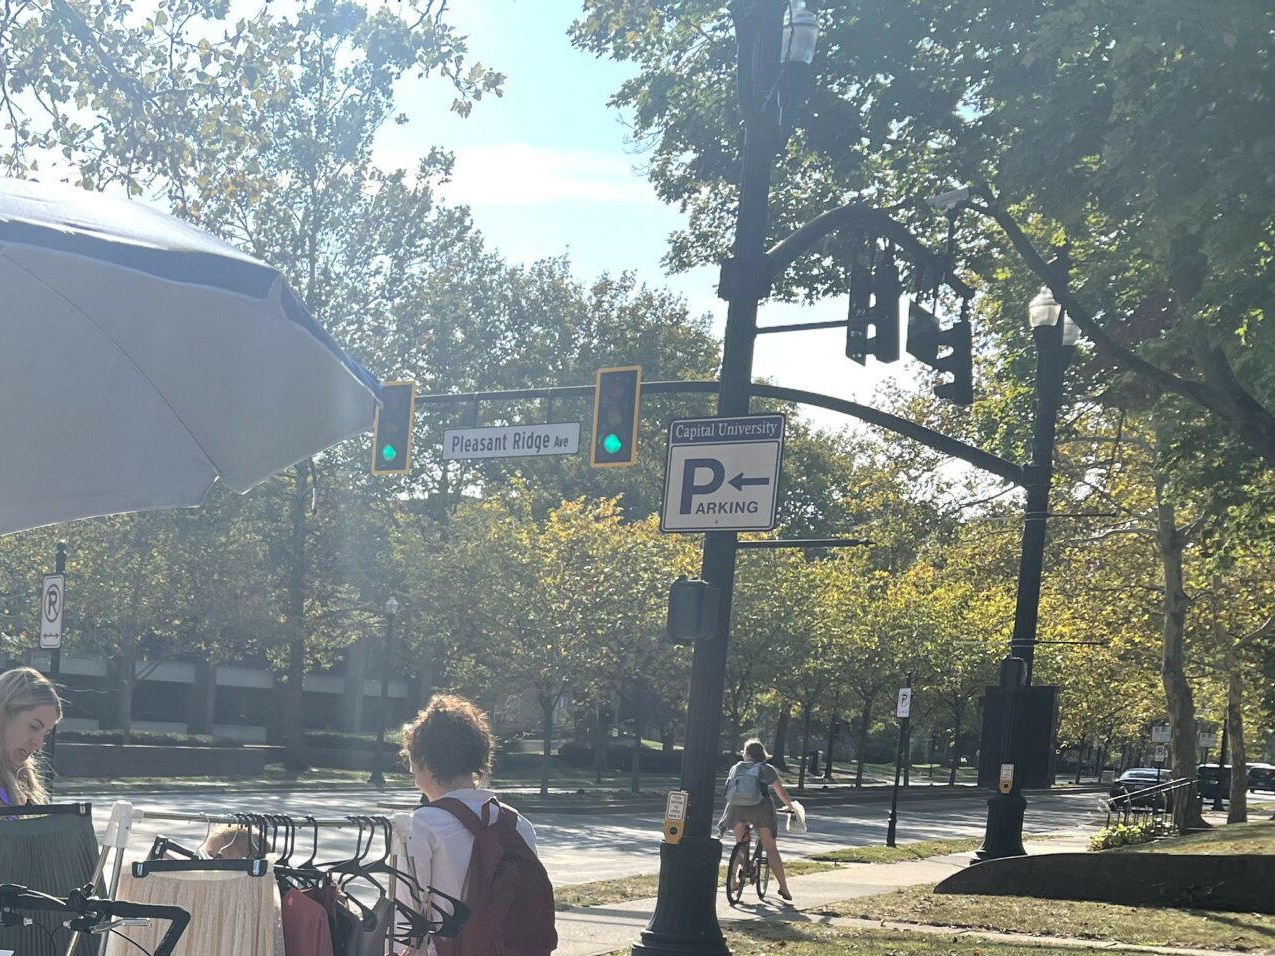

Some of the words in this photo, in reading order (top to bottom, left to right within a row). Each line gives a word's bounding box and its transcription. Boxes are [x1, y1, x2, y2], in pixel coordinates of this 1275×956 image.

[675, 424, 715, 440] Capital
[719, 421, 777, 436] University
[451, 433, 507, 453] Pleasant
[513, 431, 550, 453] Ridge
[554, 436, 569, 448] Ave
